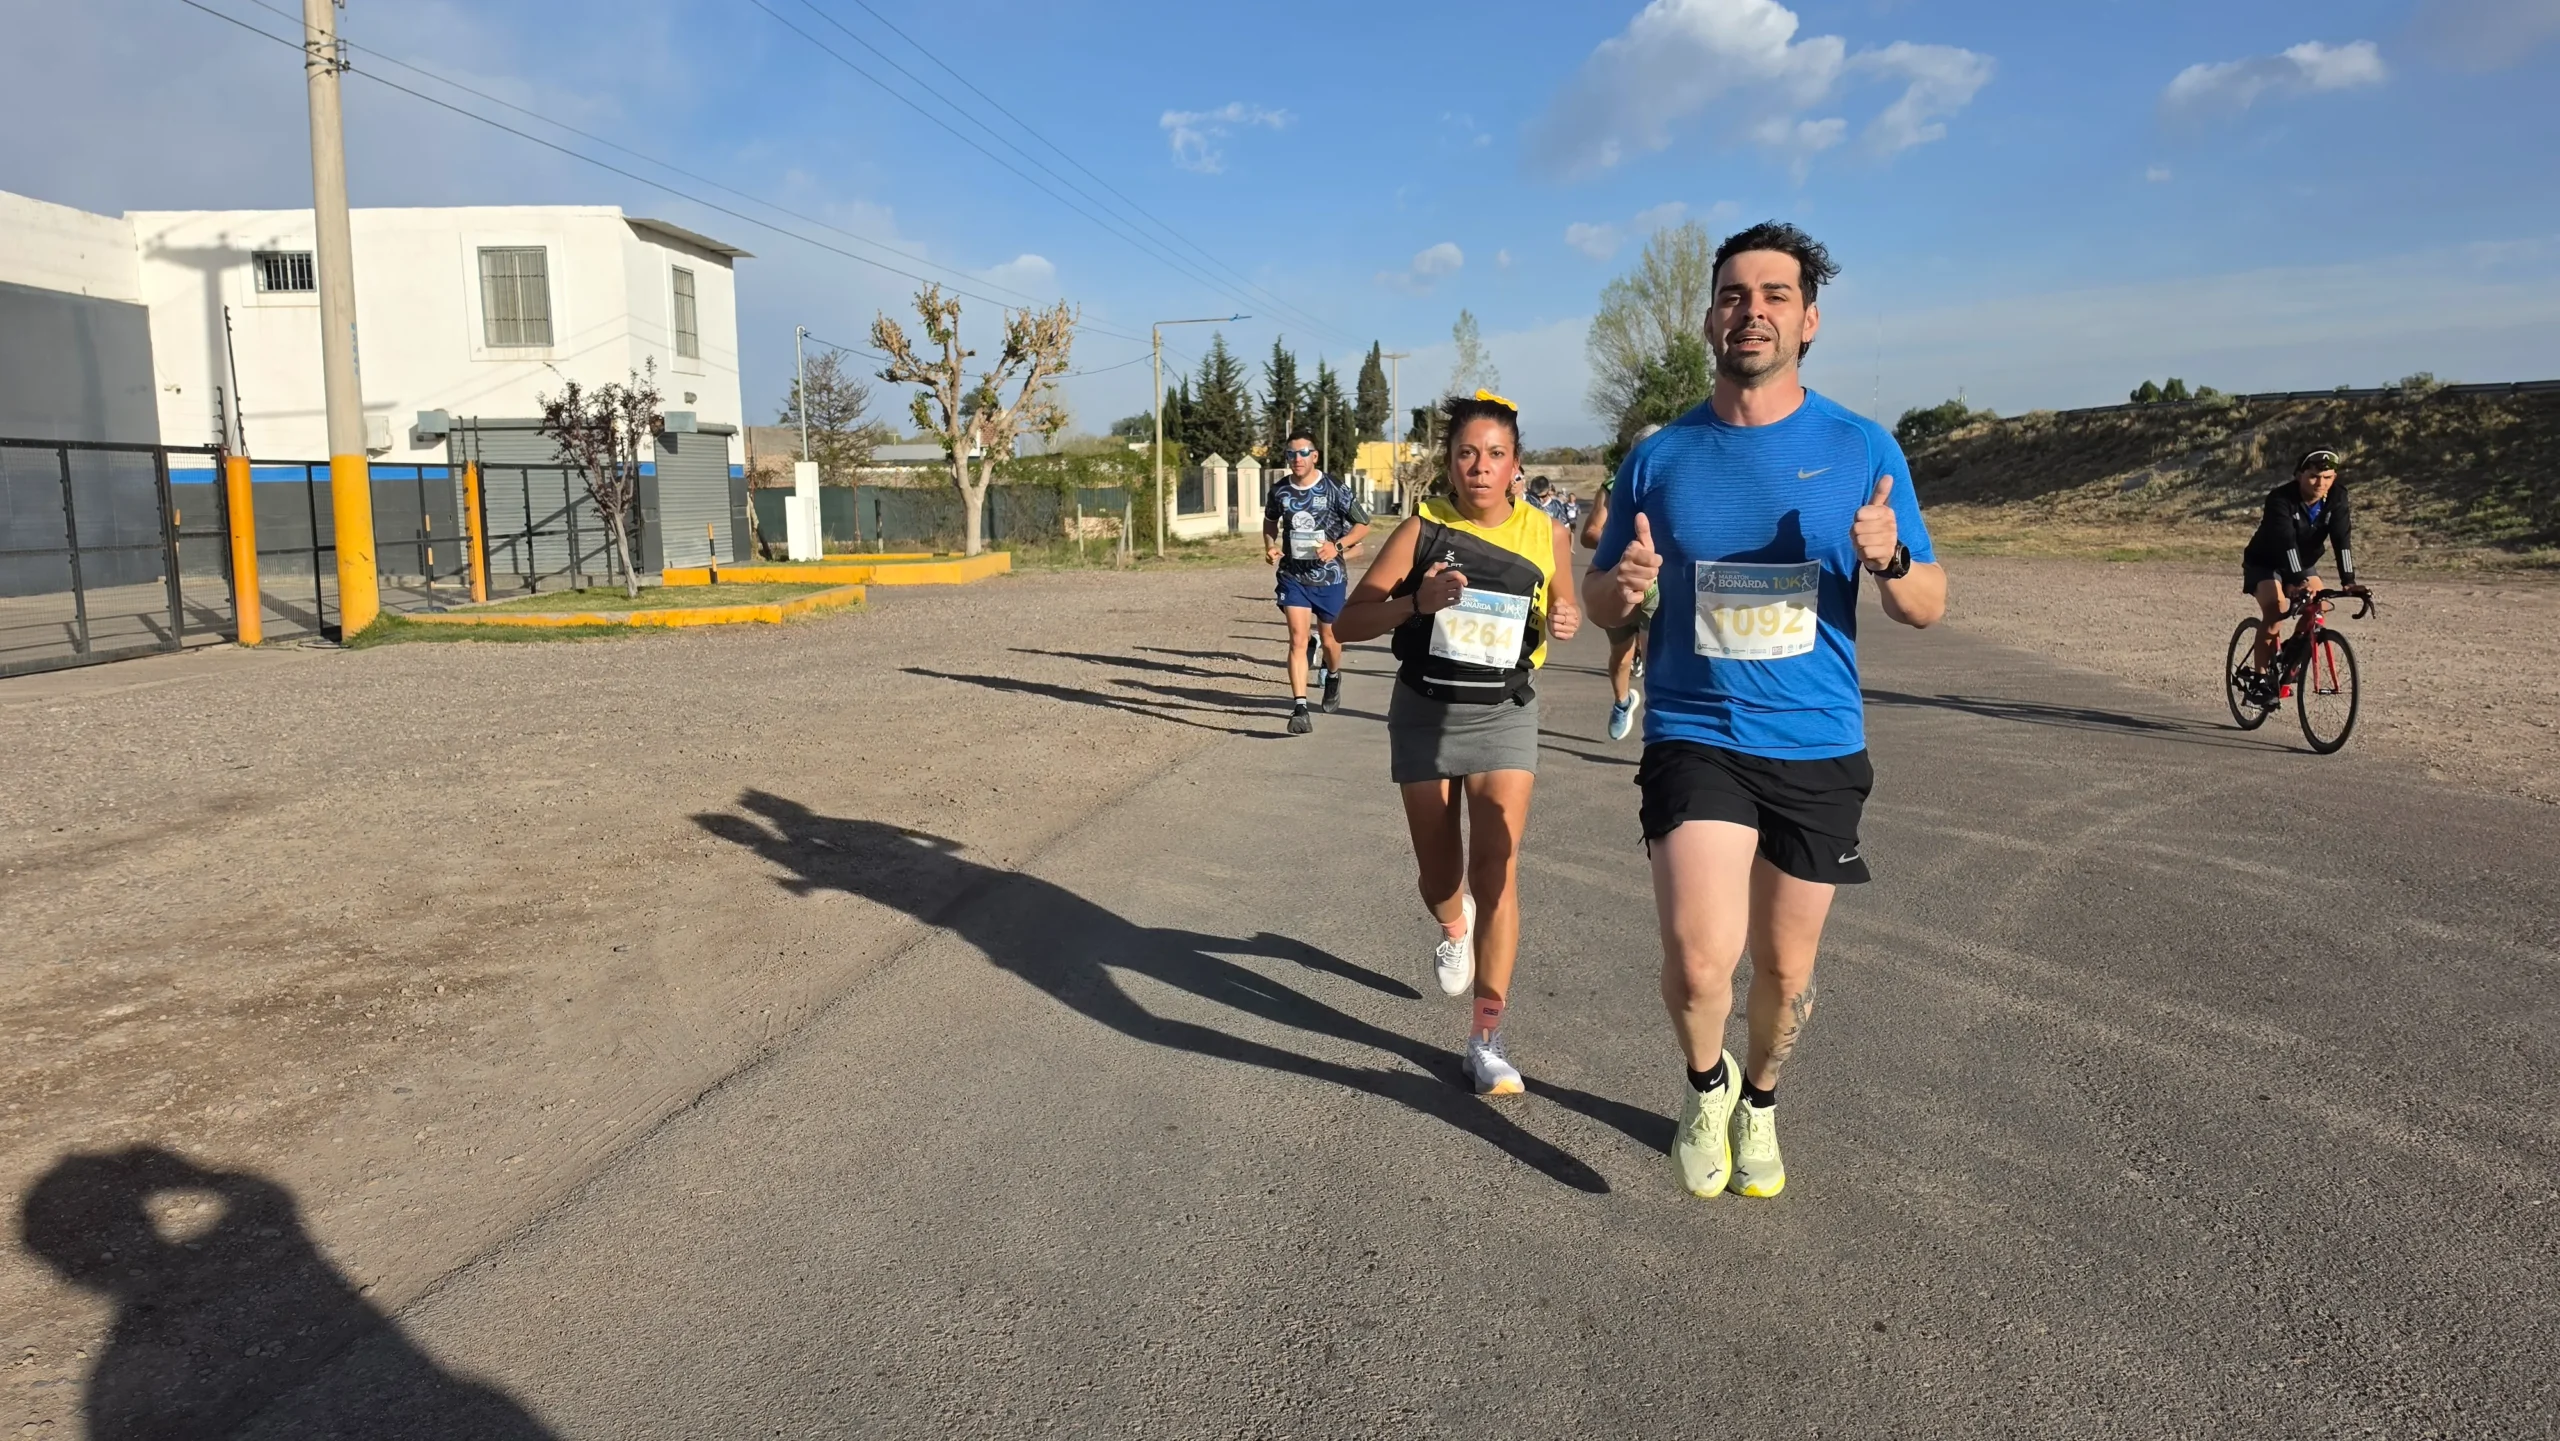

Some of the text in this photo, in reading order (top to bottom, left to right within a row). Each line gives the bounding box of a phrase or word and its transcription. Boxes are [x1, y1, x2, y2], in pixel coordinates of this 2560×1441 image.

[1718, 575, 1801, 590] BONARDA 10K
[1459, 601, 1515, 615] ONARDA 10K
[1710, 602, 1804, 637] 1092
[1446, 617, 1513, 649] 1264
